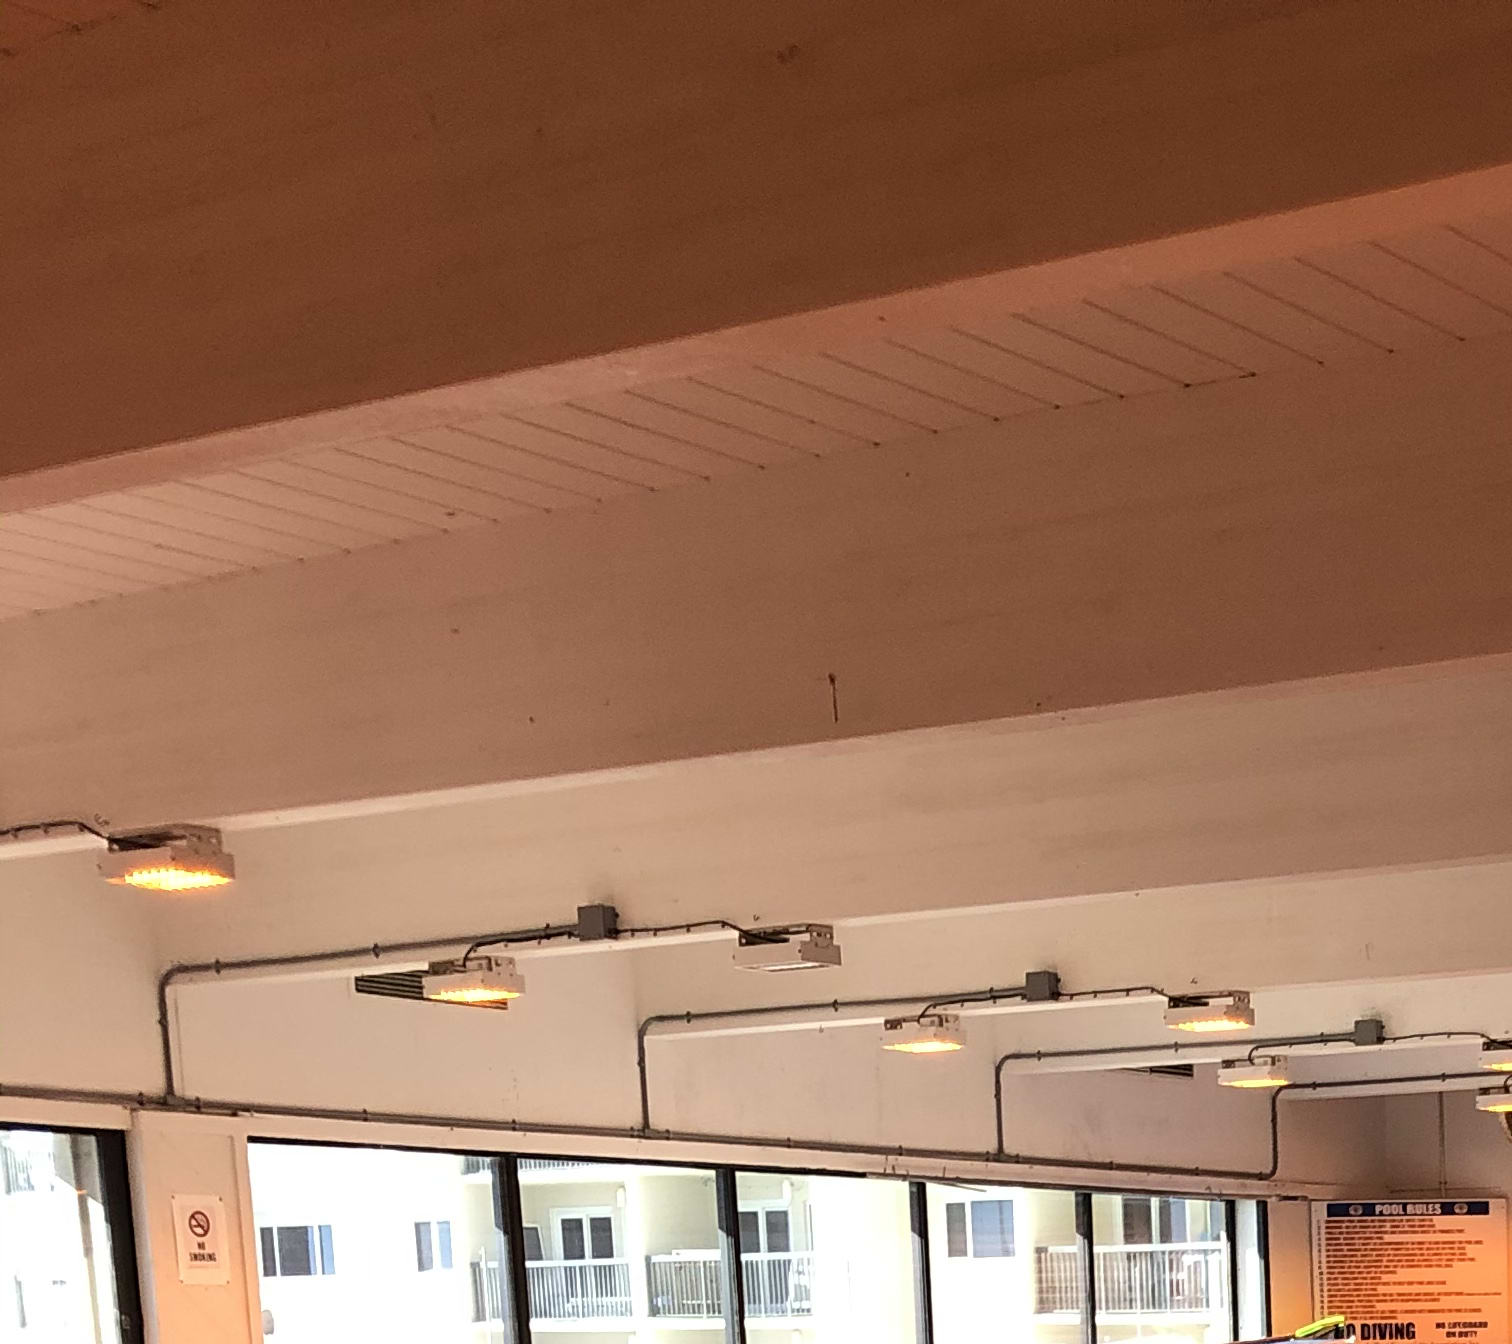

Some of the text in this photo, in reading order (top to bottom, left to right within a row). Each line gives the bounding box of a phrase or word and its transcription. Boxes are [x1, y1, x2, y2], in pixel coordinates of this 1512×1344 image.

[1375, 1203, 1442, 1215] POOL RULES
[197, 1241, 206, 1251] NO
[189, 1252, 217, 1262] SMOKING
[1360, 1322, 1416, 1341] DIVING
